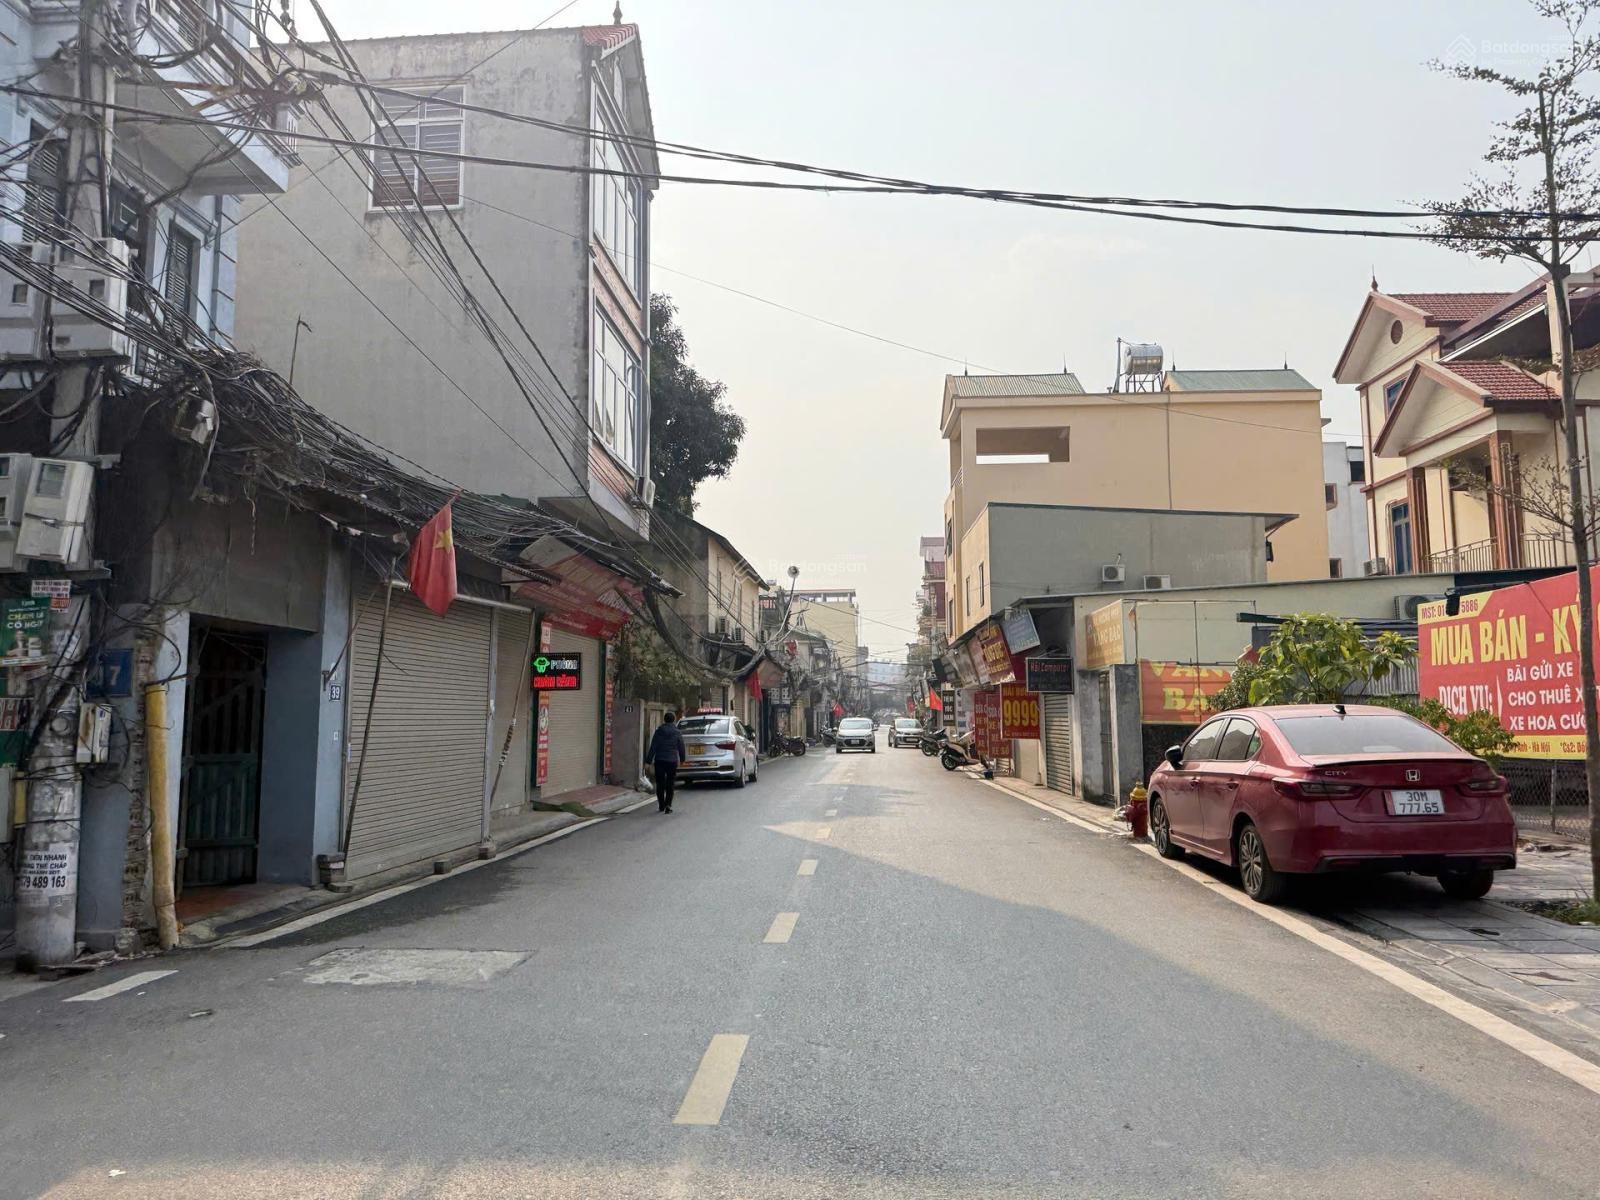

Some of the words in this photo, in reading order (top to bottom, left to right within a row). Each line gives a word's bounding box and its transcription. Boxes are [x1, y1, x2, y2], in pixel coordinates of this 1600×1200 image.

[1431, 624, 1474, 666] MUA
[1479, 609, 1527, 662] BÁN
[1507, 664, 1526, 682] BÃI
[1530, 659, 1553, 680] GỬI
[1557, 662, 1573, 678] XE
[331, 686, 340, 699] 39
[1508, 691, 1536, 707] CHO
[1539, 683, 1571, 705] THUÊ
[1575, 687, 1584, 703] X
[1004, 699, 1039, 726] 9999
[1509, 715, 1524, 730] XE
[1527, 715, 1557, 730] HOA
[1406, 791, 1428, 801] 30M
[1400, 803, 1439, 813] 777.65
[33, 876, 48, 888] 489
[51, 876, 66, 888] 163
